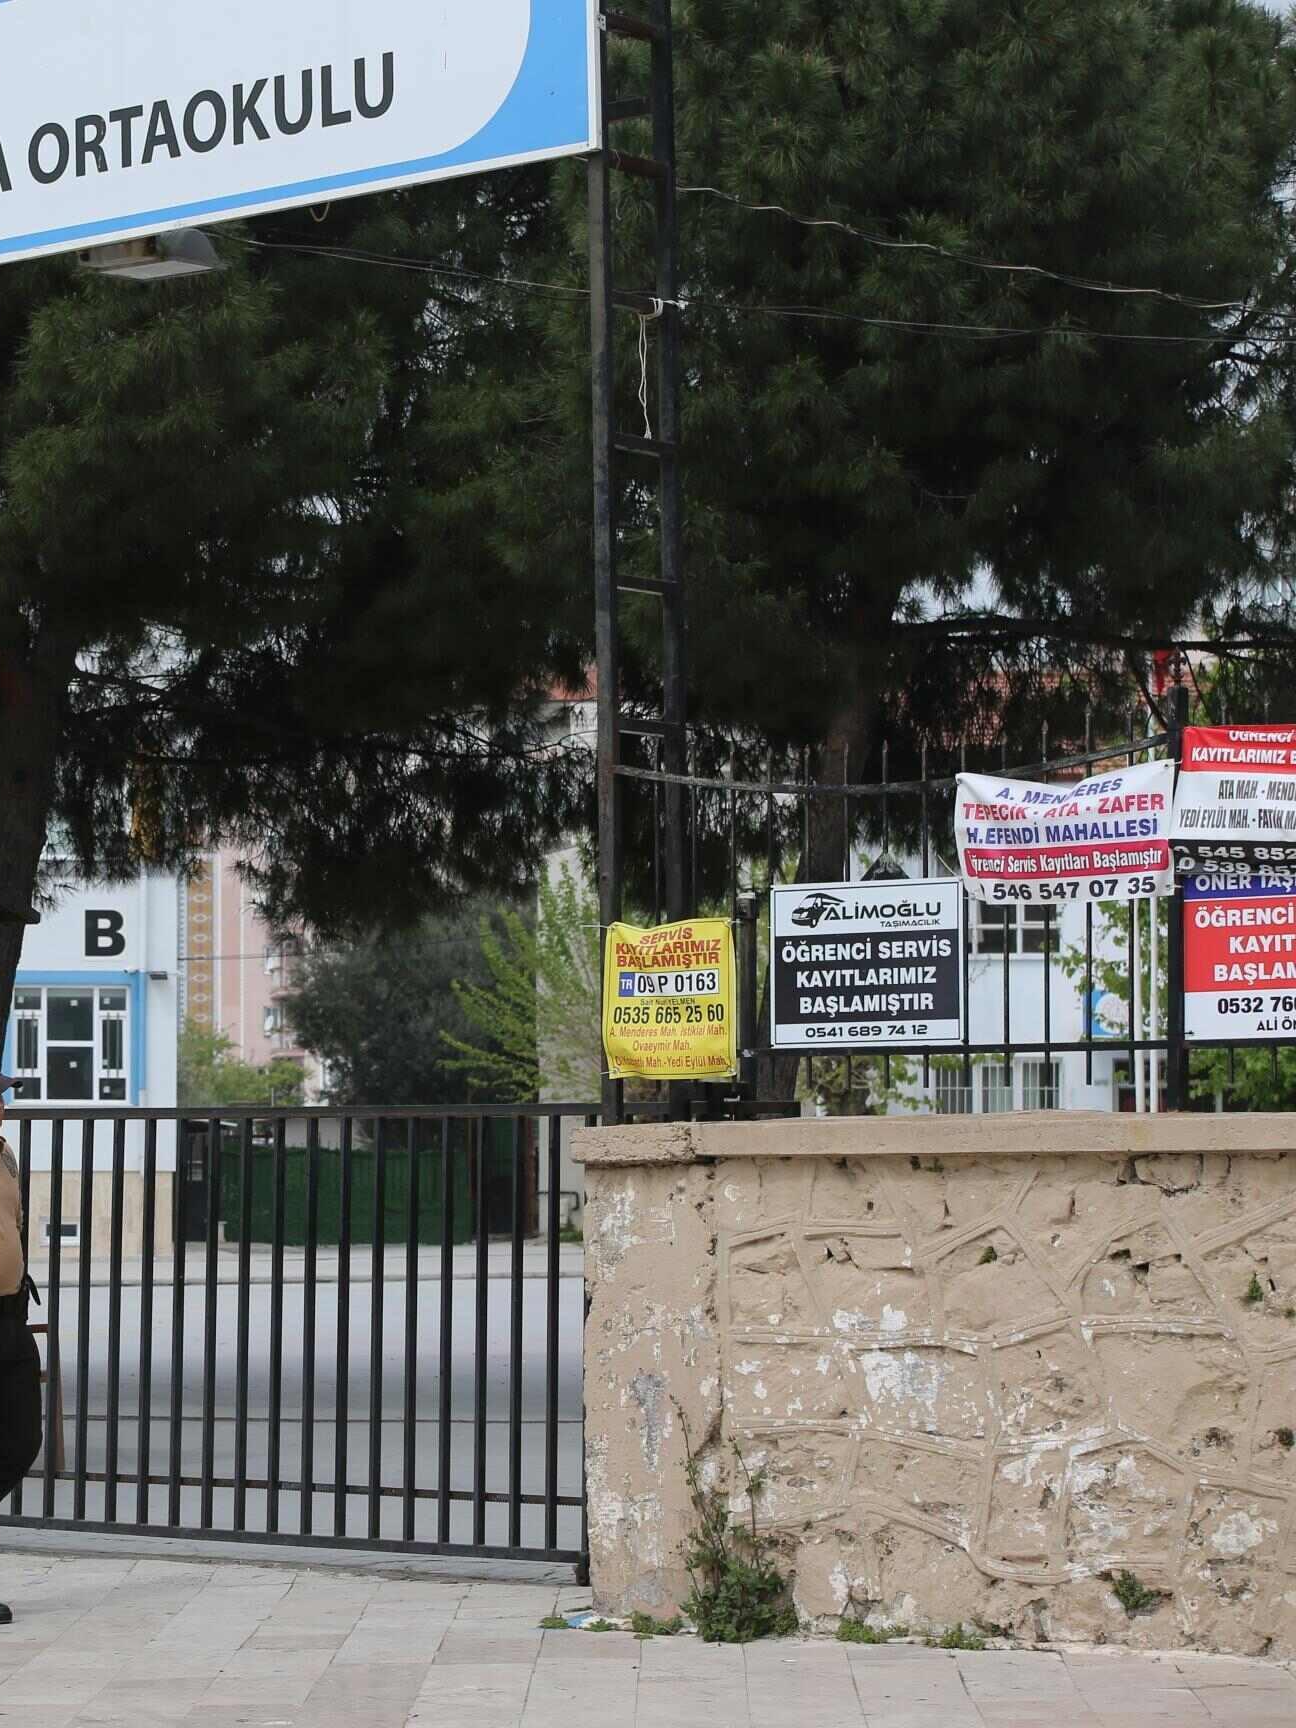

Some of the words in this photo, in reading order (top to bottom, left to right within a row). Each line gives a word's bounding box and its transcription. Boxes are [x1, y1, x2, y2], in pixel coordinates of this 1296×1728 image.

[27, 51, 395, 185] ORTAOKULU
[1191, 747, 1286, 765] KAYITLARIMIZ
[995, 786, 1016, 801] A.
[1218, 779, 1235, 800] ATA
[1236, 780, 1258, 800] MAH.
[962, 803, 1028, 822] TEPECİK
[1097, 793, 1165, 815] ZAFER
[1179, 806, 1202, 829] YEDİ
[1202, 805, 1227, 829] EYLÜL
[1228, 809, 1250, 829] MAH.
[1045, 813, 1159, 844] MAHALLESİ
[971, 851, 1006, 874] ğrenci
[1007, 855, 1038, 874] Servis
[1039, 852, 1090, 876] Kayıtları
[1093, 847, 1163, 873] Başlamıştır
[1198, 846, 1246, 859] 545
[1203, 859, 1252, 874] 539
[992, 883, 1033, 901] 546
[1039, 881, 1080, 900] 547
[1088, 879, 1119, 898] 07
[1127, 876, 1155, 895] 35
[1260, 875, 1296, 893] TAŞ
[824, 900, 942, 922] ALİMOĞLU
[1194, 901, 1295, 929] ÖĞRENCİ
[84, 909, 126, 957] B
[879, 918, 941, 929] TAŞIMACILIK
[615, 938, 722, 955] KAYITLARIMIZ
[640, 927, 693, 945] SERVİS
[1229, 933, 1296, 955] KAYIT
[781, 937, 872, 964] ÖĞRENCİ
[878, 934, 952, 960] SERVİS
[616, 951, 721, 970] BAŞLAMIŞTIR
[621, 978, 633, 990] TR
[637, 974, 656, 994] 09
[658, 974, 668, 993] P
[674, 971, 717, 993] 0163
[796, 966, 937, 989] KAYITLARIMIZ
[613, 1006, 650, 1025] 0535
[655, 1005, 682, 1024] 665
[685, 1005, 703, 1023] 25
[707, 1003, 724, 1022] 60
[799, 992, 935, 1018] BAŞLAMIŞTIR
[1217, 996, 1264, 1015] 0532
[619, 1026, 658, 1038] Menderes
[707, 1023, 728, 1036] Mah.
[805, 1026, 843, 1039] 0541
[848, 1025, 882, 1038] 689
[887, 1024, 907, 1037] 74
[912, 1024, 929, 1036] 12
[1256, 1015, 1278, 1032] ALİ
